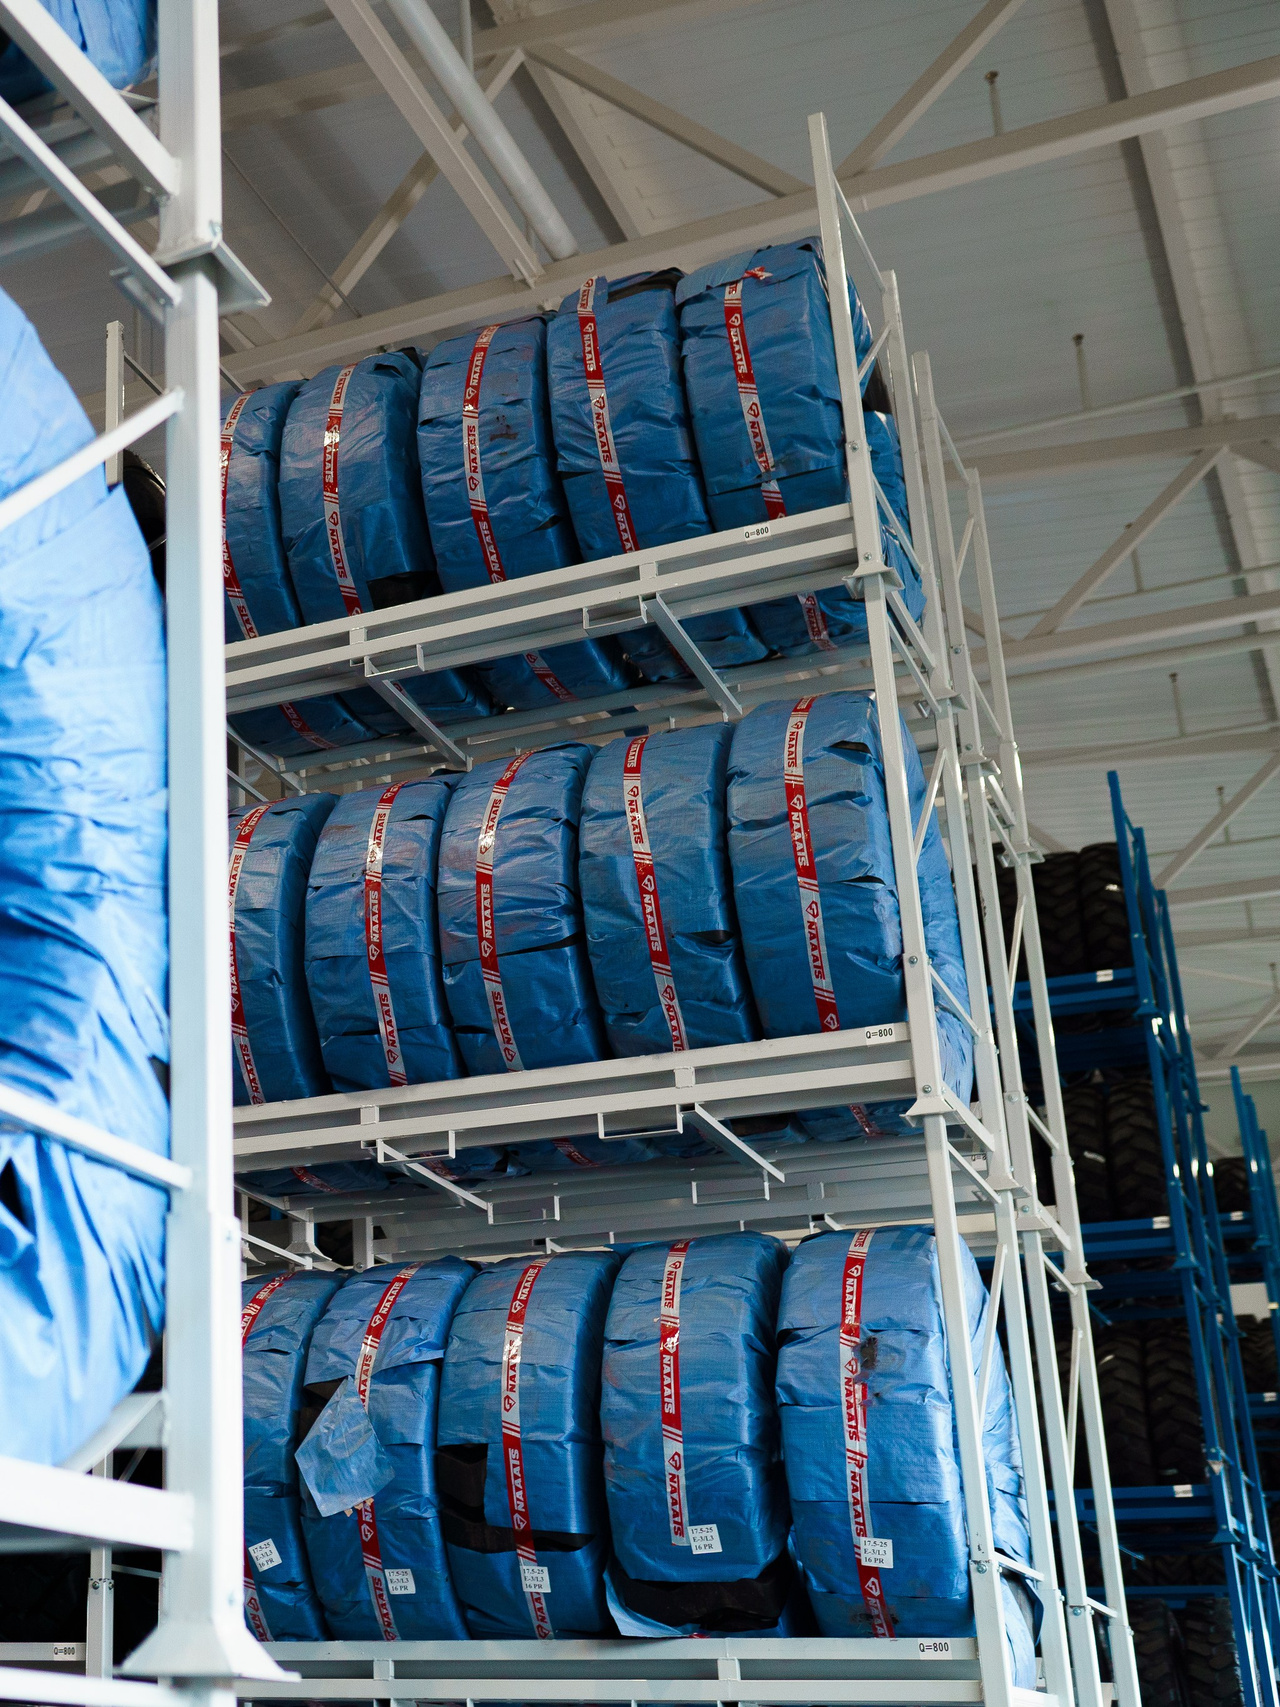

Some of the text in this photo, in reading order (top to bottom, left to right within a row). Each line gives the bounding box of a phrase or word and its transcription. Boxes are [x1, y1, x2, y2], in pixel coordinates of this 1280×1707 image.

[745, 526, 769, 539] Q=800
[865, 1027, 894, 1040] Q=800
[691, 1526, 714, 1535] 17.5-25
[863, 1540, 888, 1548] 17.5-25
[864, 1556, 885, 1565] 16 PR
[53, 1646, 76, 1656] Q=800
[918, 1642, 950, 1653] Q=800
